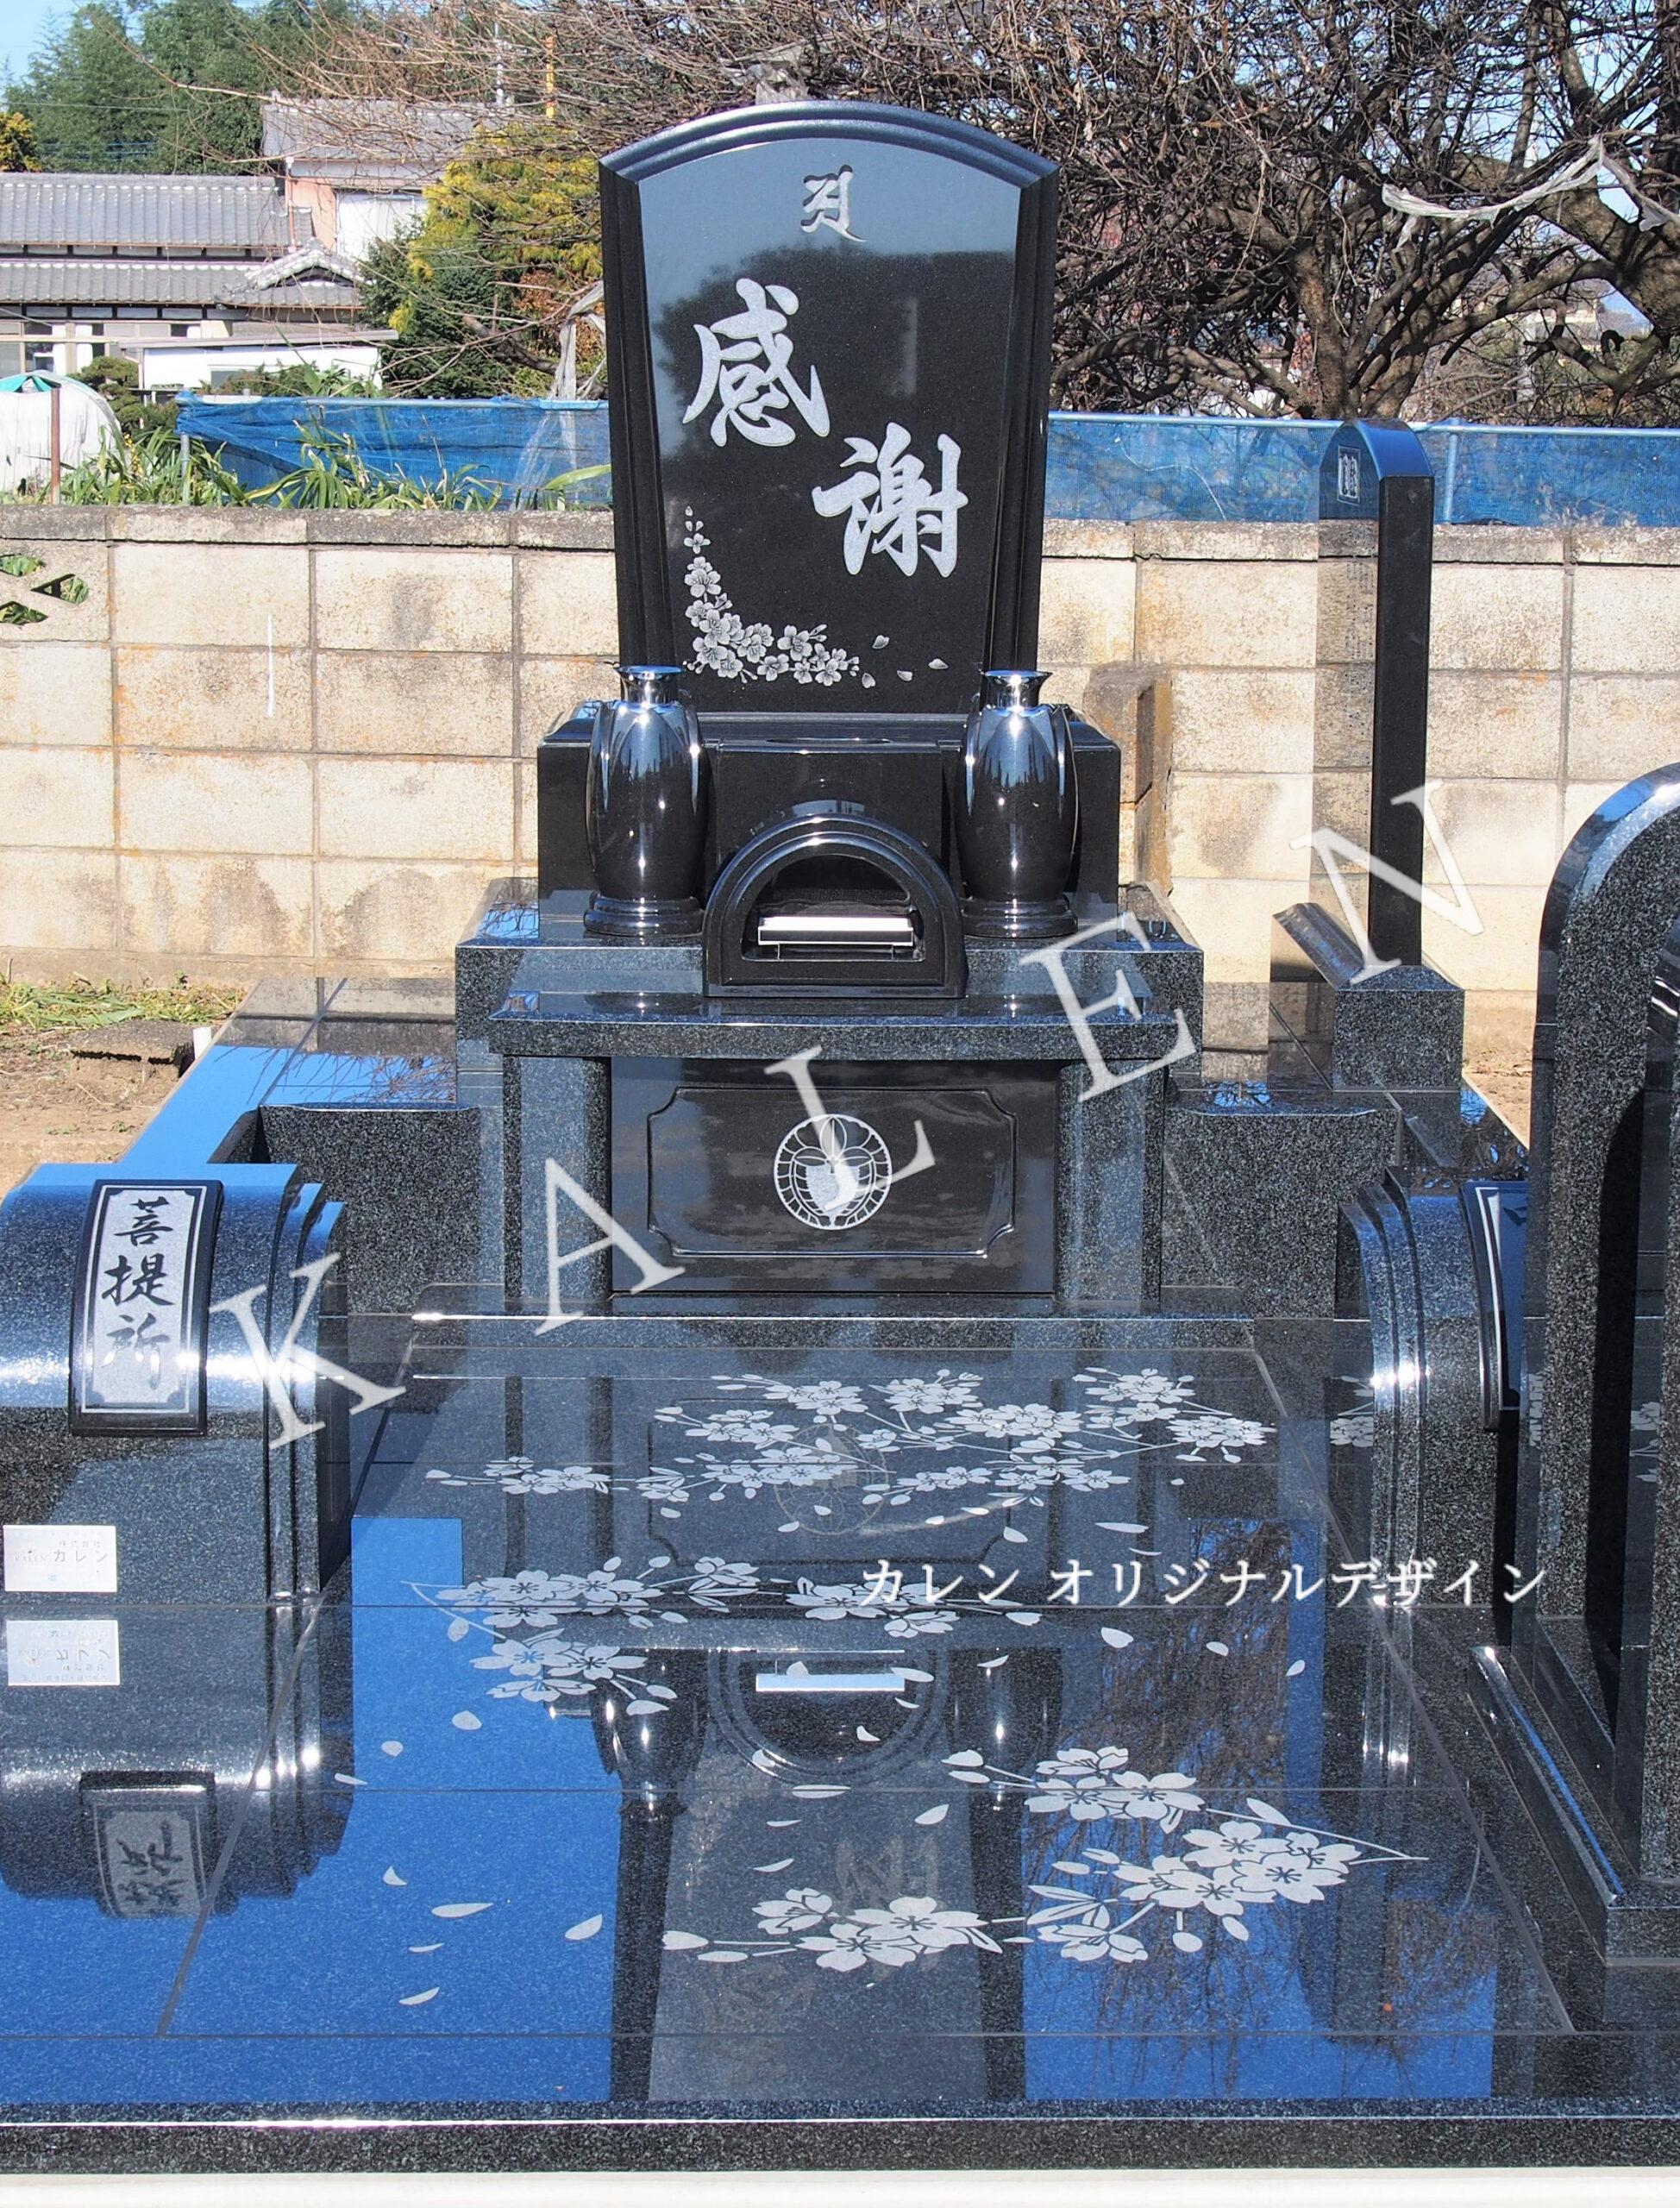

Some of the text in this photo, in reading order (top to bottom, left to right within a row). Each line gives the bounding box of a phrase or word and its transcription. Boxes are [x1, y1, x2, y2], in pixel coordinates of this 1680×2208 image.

[682, 278, 969, 578] 感謝
[101, 1196, 174, 1389] 菩提所
[53, 1549, 109, 1564] カレン
